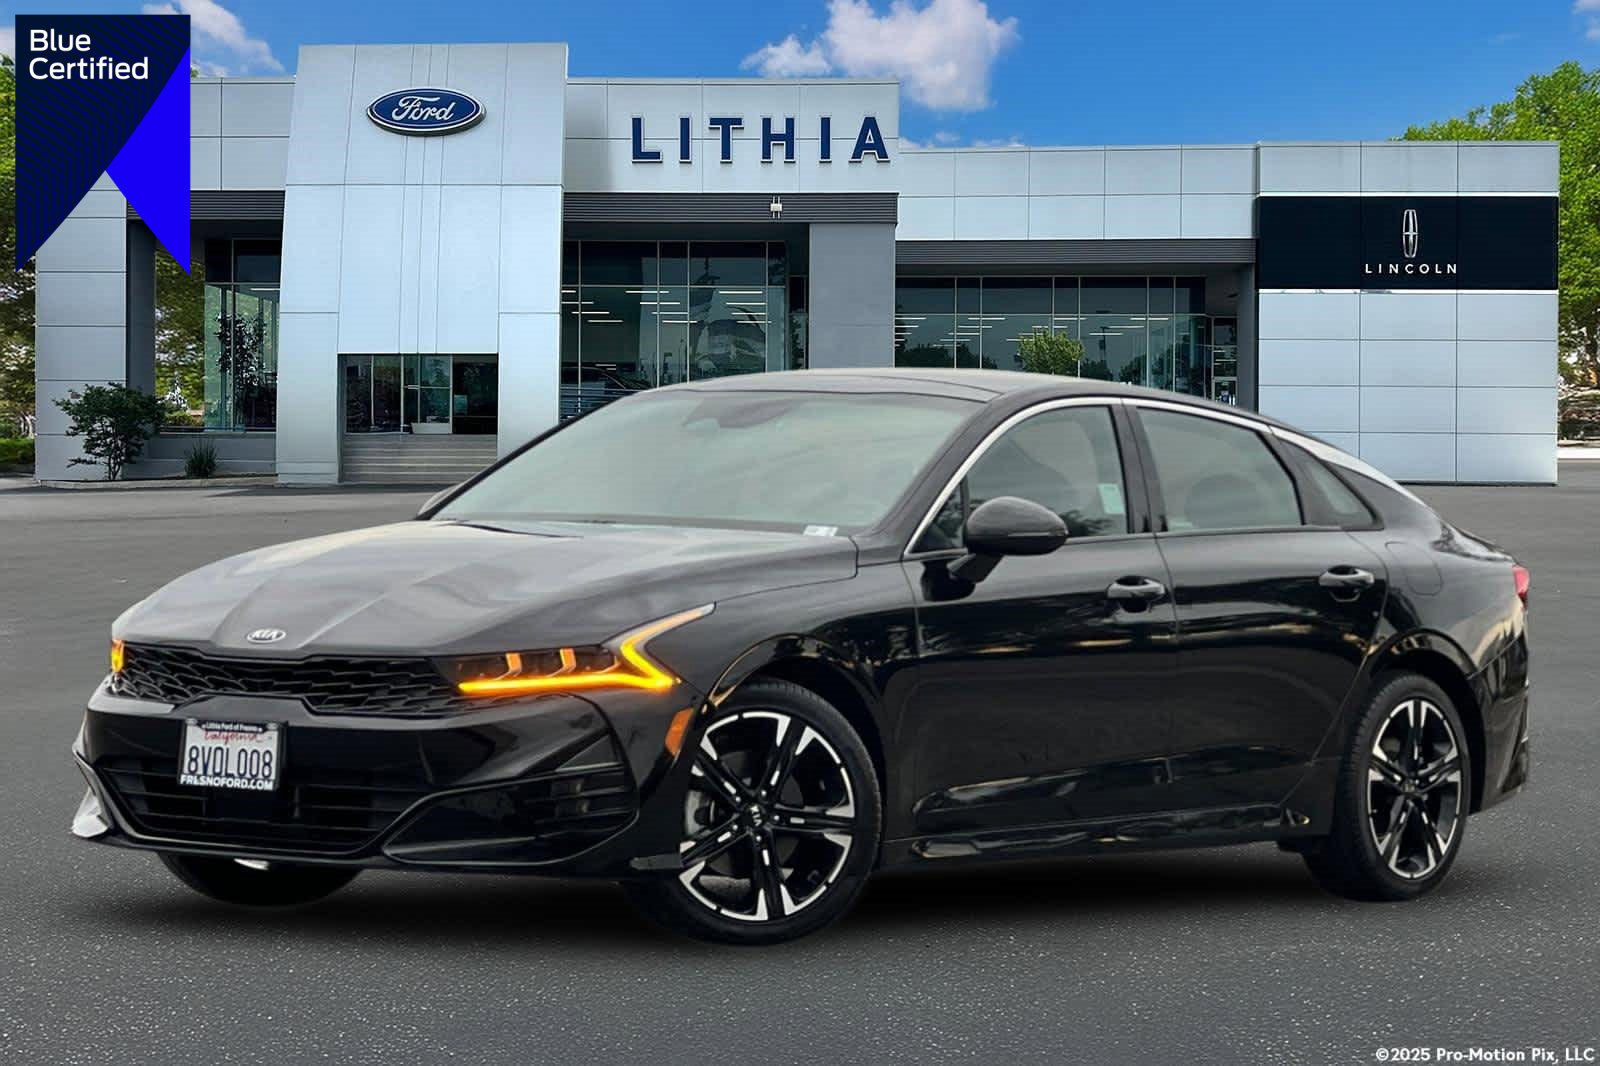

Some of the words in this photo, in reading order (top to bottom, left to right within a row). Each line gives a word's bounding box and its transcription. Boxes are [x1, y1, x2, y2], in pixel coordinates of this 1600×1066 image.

[391, 95, 456, 121] Ford
[631, 116, 890, 164] LITHIA
[1365, 263, 1457, 274] LINCOLN
